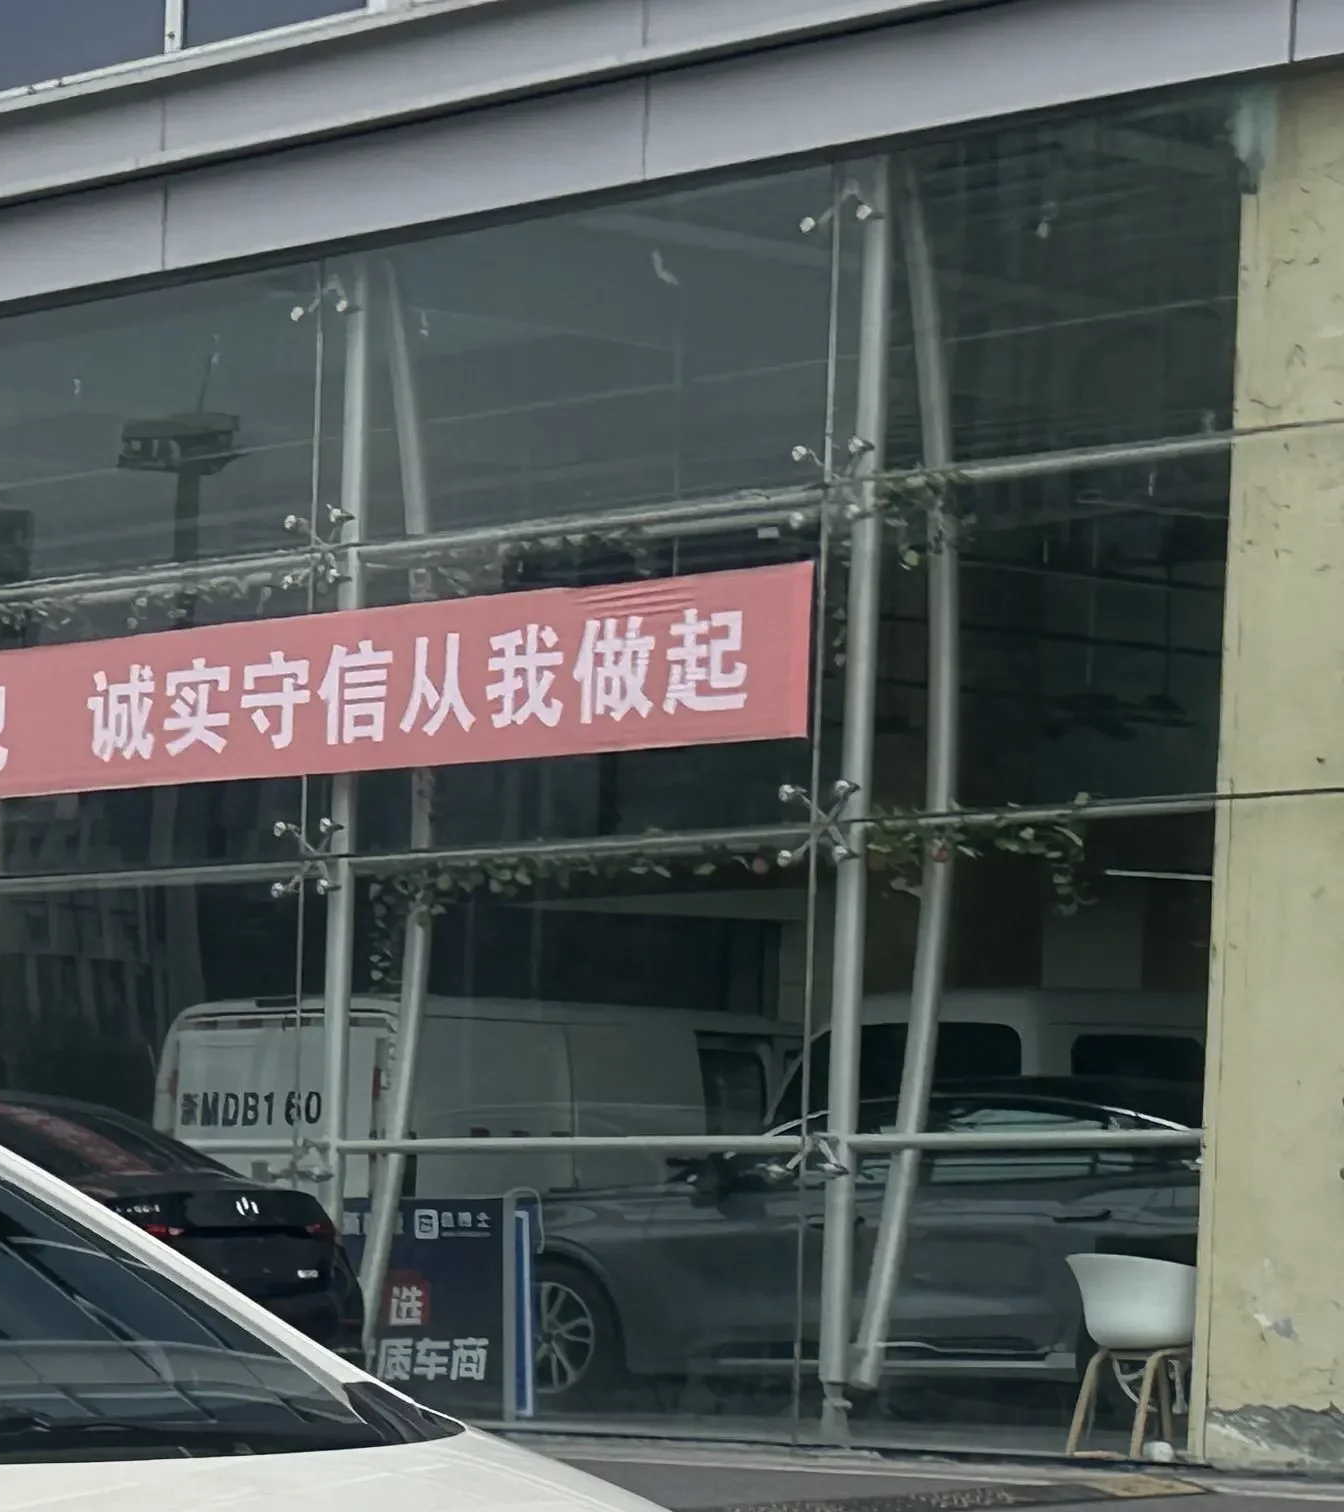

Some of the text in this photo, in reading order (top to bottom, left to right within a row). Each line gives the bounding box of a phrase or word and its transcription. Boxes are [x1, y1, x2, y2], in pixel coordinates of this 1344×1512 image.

[88, 607, 749, 763] 诚实守信从我做起
